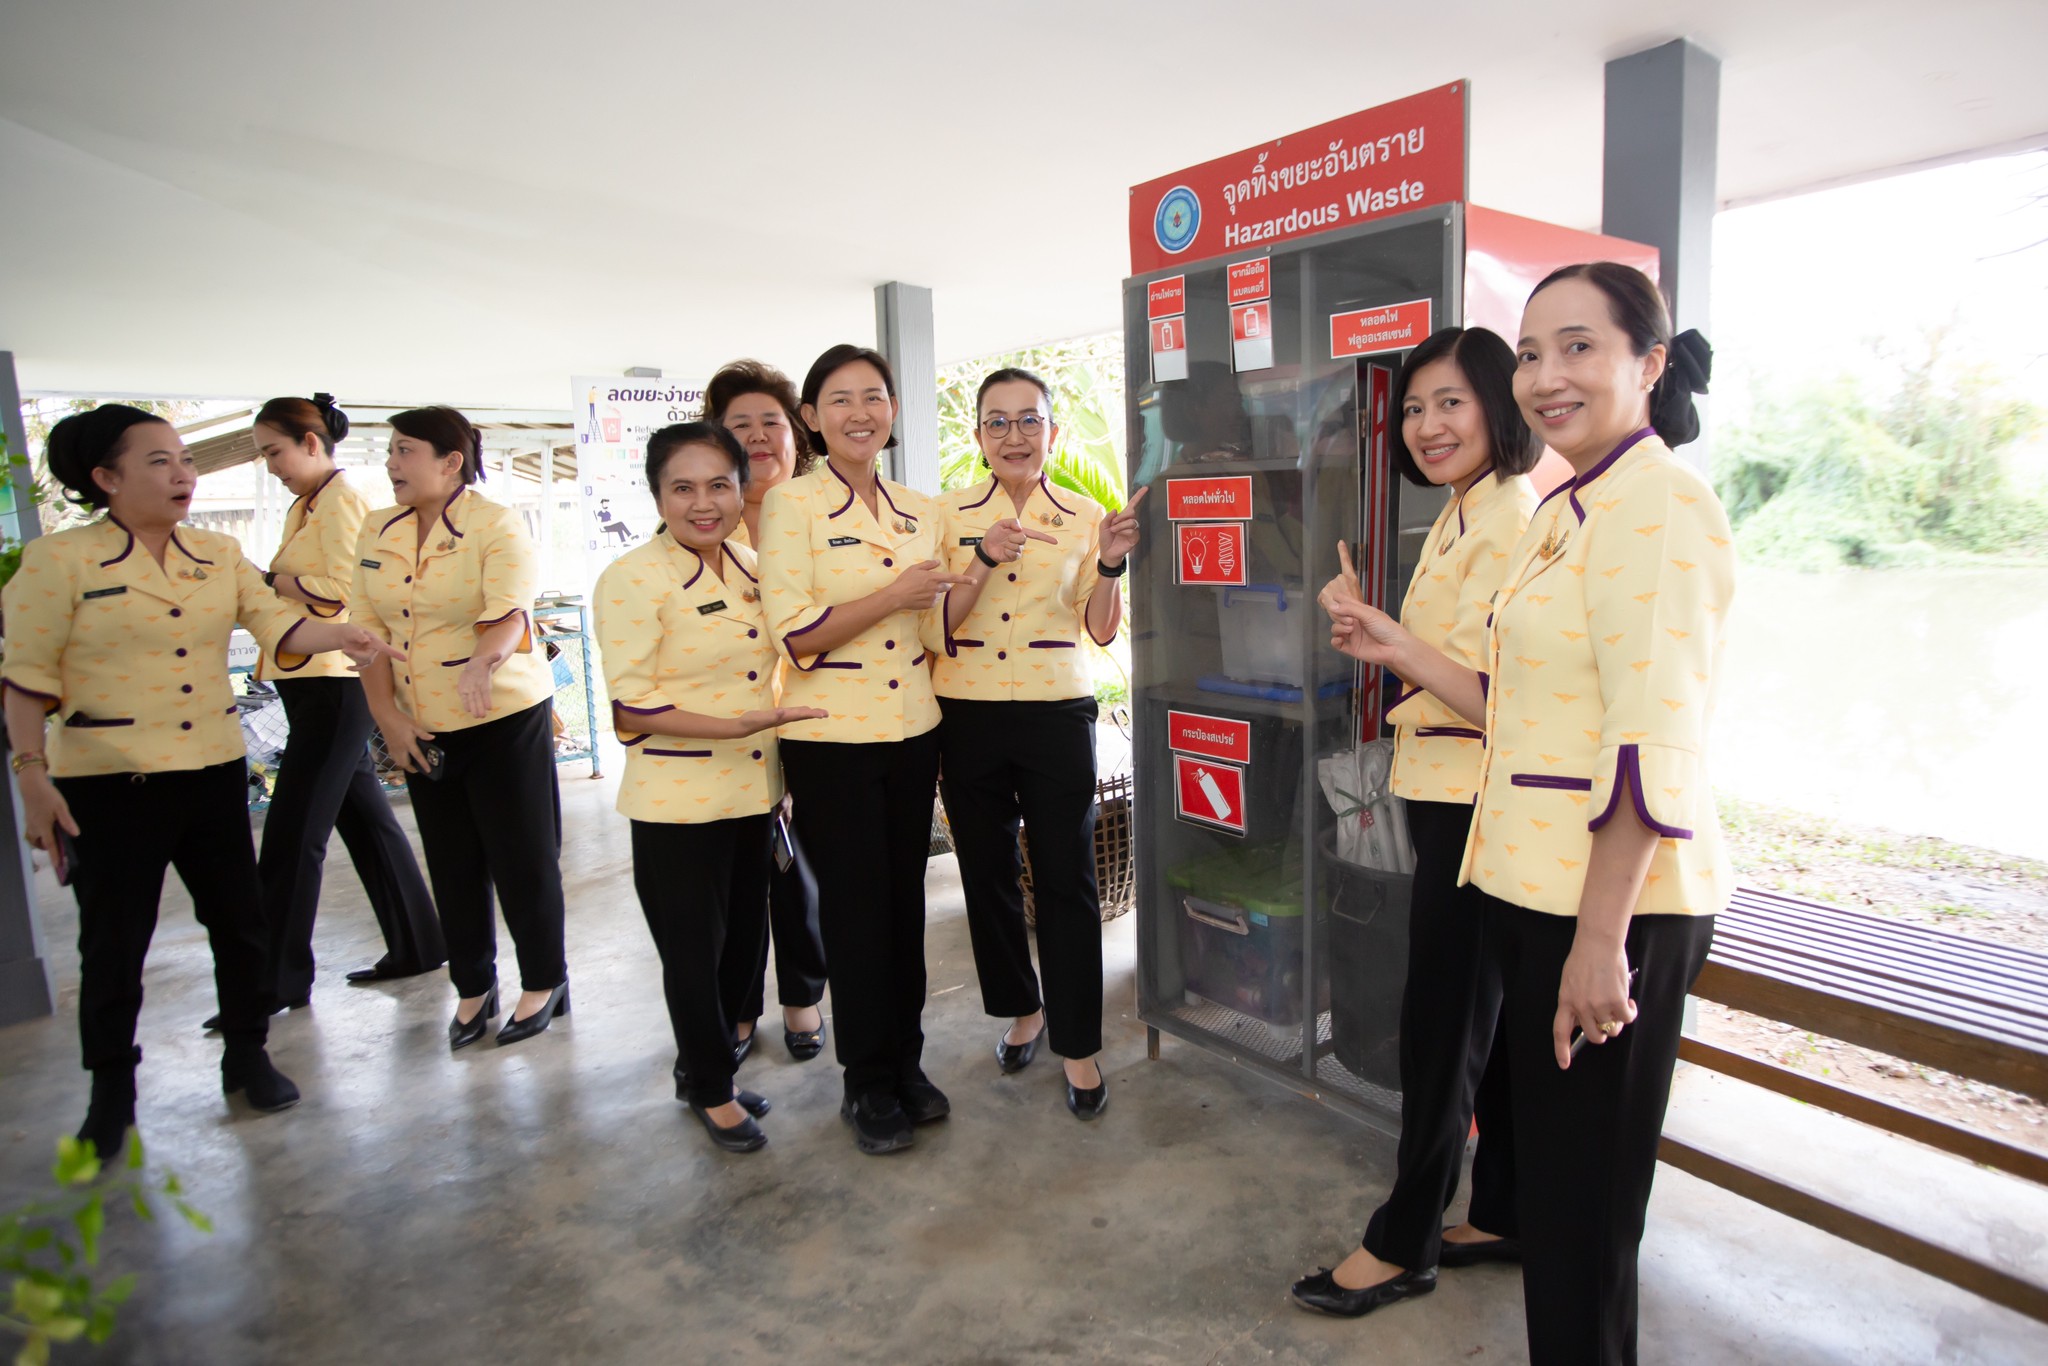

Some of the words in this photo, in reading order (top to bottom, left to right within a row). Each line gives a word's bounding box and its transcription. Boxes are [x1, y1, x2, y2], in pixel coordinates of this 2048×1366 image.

[1222, 126, 1425, 216] จุดทิ้งขยะอันตราย
[1224, 202, 1340, 248] Hazardous
[1346, 178, 1425, 218] Waste
[1231, 261, 1265, 279] ซากมือถือ
[1150, 287, 1182, 302] ถ่านไฟฉาย
[1359, 309, 1399, 328] หลอดไฟ
[1347, 322, 1413, 349] ฟลูออเรสเซนต์
[667, 405, 700, 421] ด้วย
[1182, 487, 1236, 504] หลอดไฟทั่วไป
[228, 646, 258, 656] ขาวด
